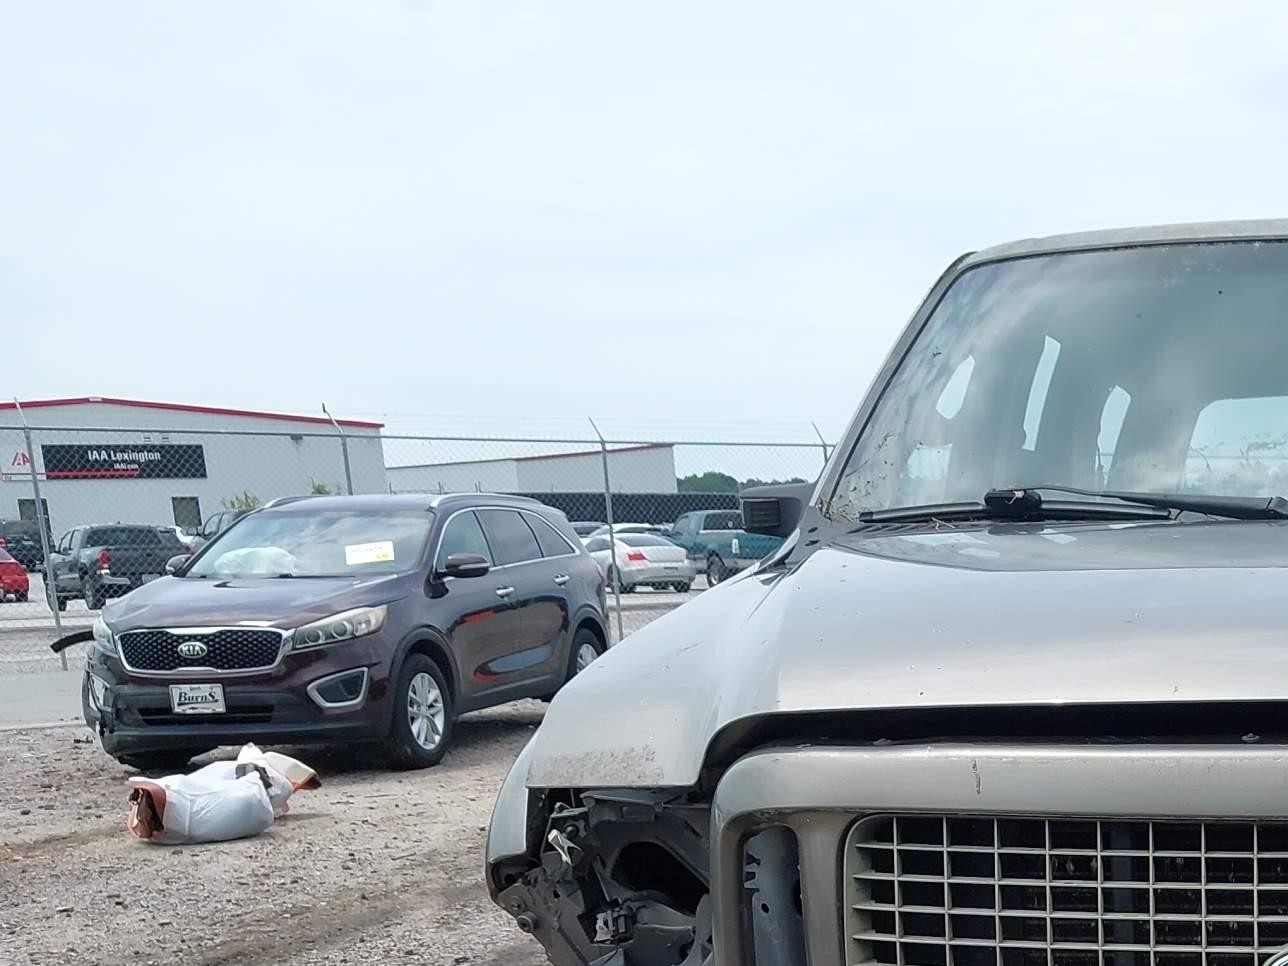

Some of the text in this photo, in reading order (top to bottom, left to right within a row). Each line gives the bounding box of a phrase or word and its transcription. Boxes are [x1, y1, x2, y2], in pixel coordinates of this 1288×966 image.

[87, 450, 161, 462] IAA Lexington
[182, 644, 202, 655] KIA
